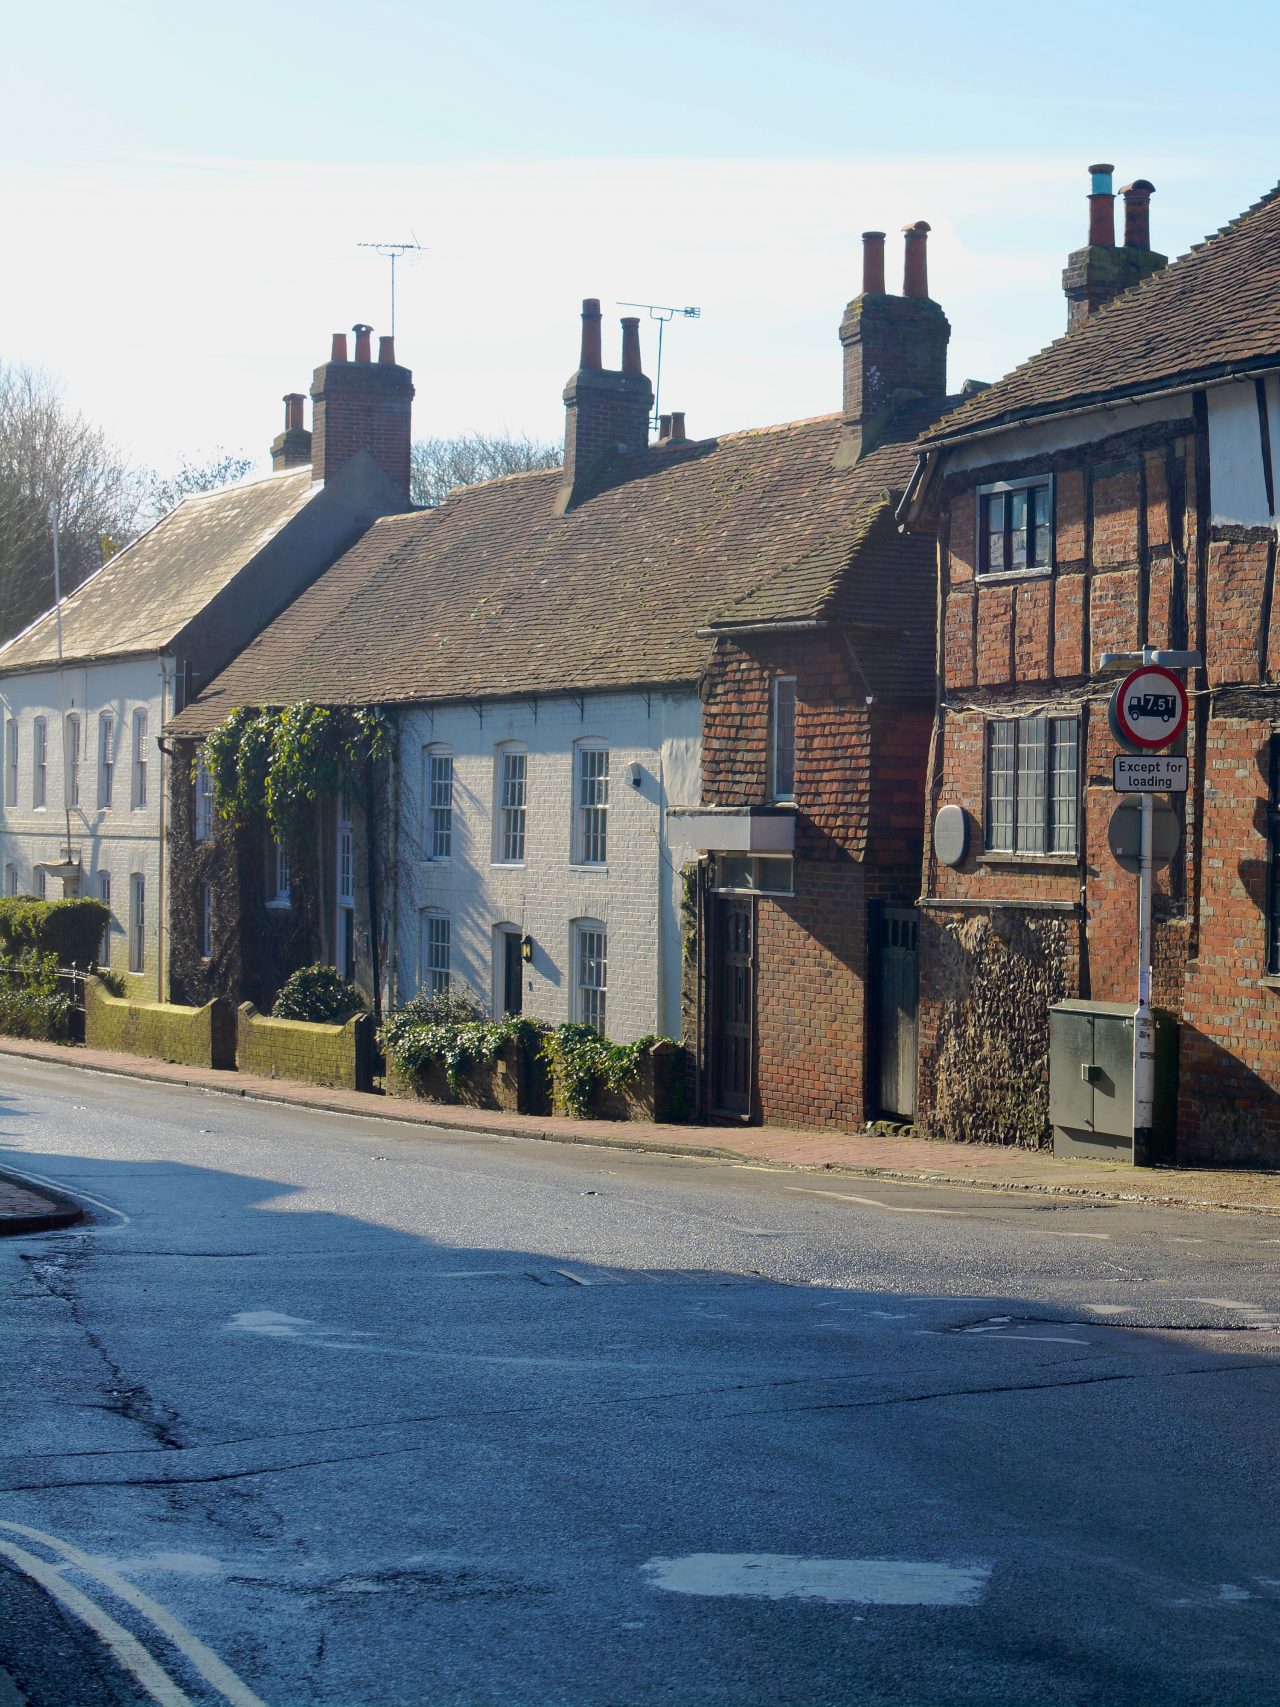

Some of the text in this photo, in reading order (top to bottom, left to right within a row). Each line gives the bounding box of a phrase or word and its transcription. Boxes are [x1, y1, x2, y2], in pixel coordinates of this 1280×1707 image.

[1145, 696, 1174, 710] 7.5T
[1119, 761, 1183, 773] Except for
[1128, 776, 1172, 788] loading
